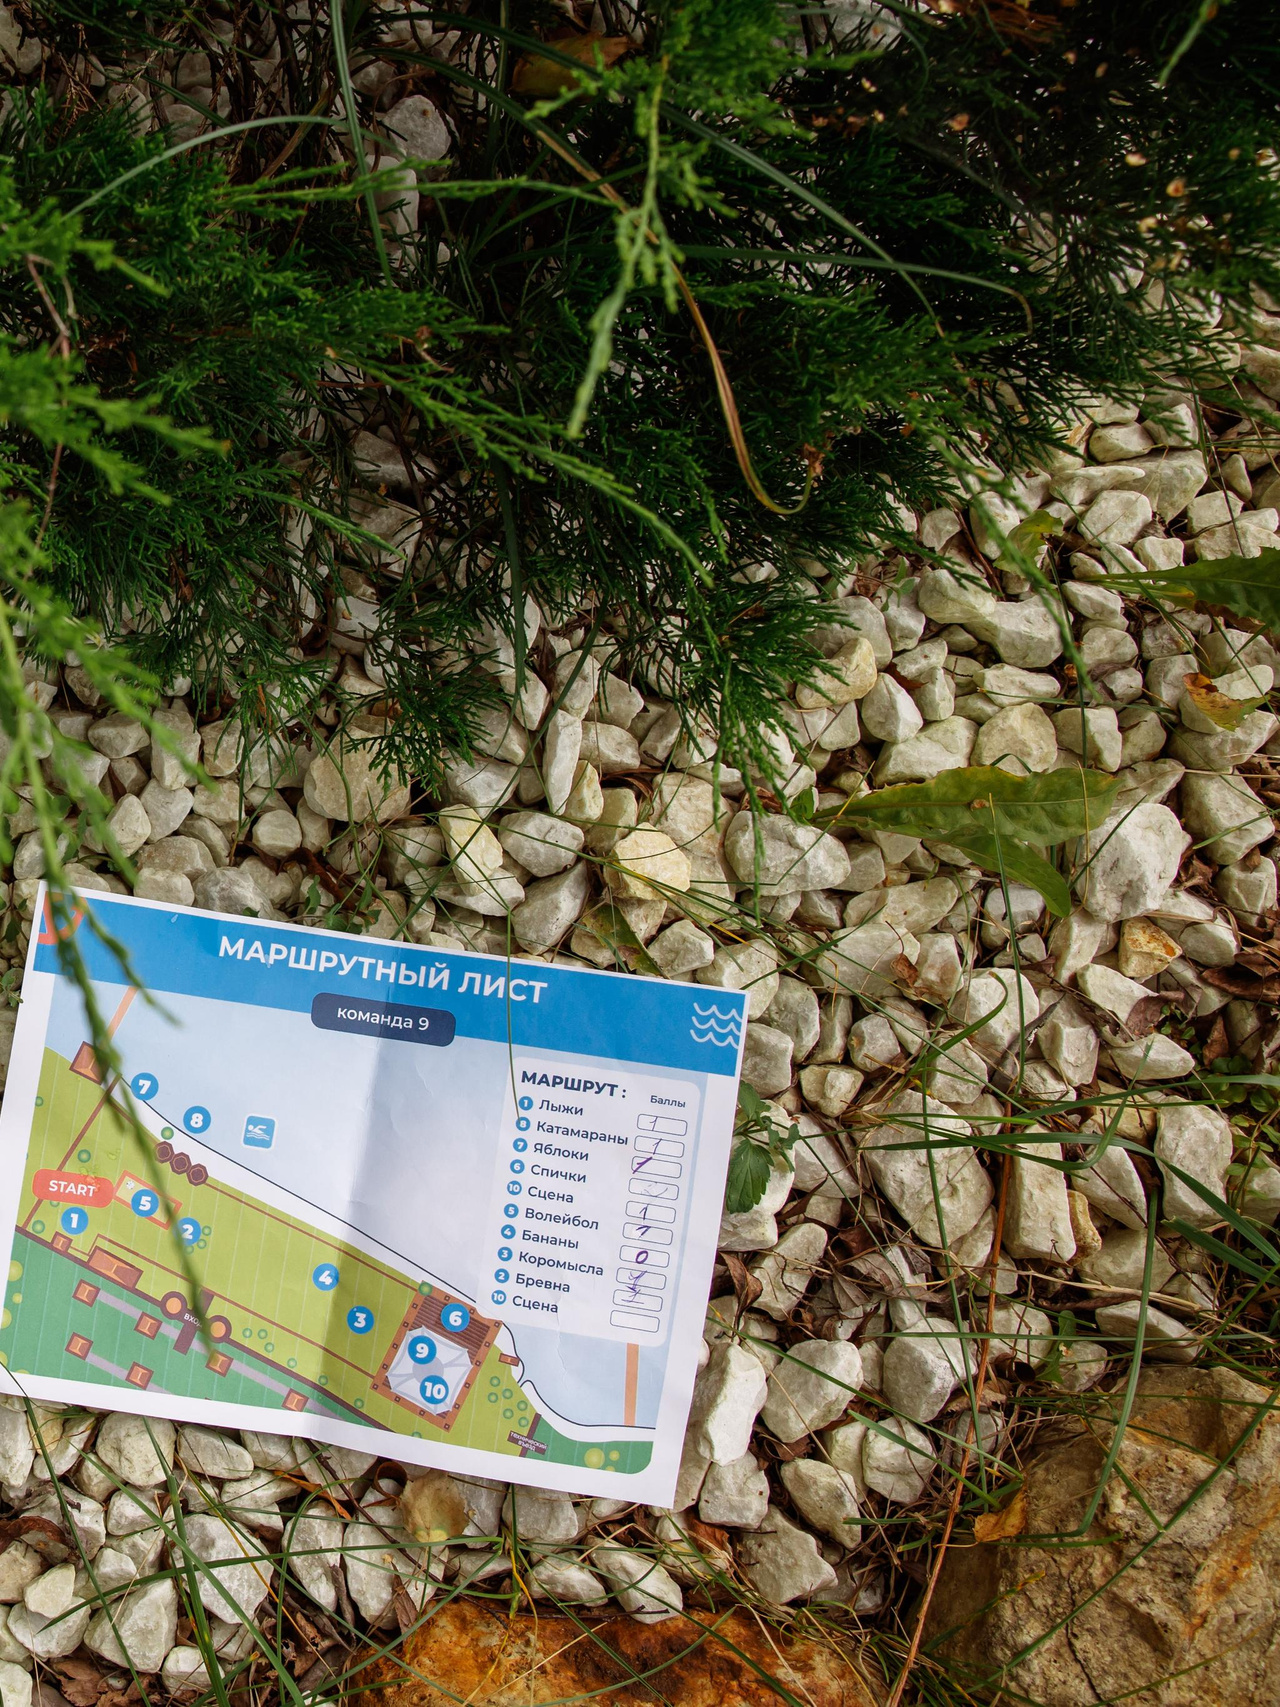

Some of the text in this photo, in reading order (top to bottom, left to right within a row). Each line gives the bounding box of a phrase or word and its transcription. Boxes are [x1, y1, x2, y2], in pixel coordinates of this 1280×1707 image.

[218, 935, 548, 1004] МАРШРУТНЫЙ ЛИСТ
[336, 1006, 430, 1031] команда 9
[138, 1079, 151, 1095] 7
[521, 1070, 618, 1097] МАРШРУТ
[539, 1099, 584, 1116] Лыжи
[650, 1095, 686, 1108] Баллы
[190, 1112, 203, 1128] 8
[536, 1120, 628, 1146] Катамараны
[533, 1142, 589, 1161] Яблоки
[530, 1164, 587, 1183] Спички
[48, 1180, 96, 1197] START
[509, 1184, 574, 1203] 10 Сцена
[138, 1196, 152, 1211] 5
[70, 1213, 79, 1228] 1
[525, 1207, 599, 1230] Волейбол
[181, 1224, 194, 1239] 2
[522, 1229, 579, 1250] Бананы
[519, 1251, 604, 1276] Коромысла
[318, 1270, 333, 1285] 4
[515, 1273, 570, 1293] Бревна
[493, 1293, 559, 1314] 10 Сцена
[354, 1312, 367, 1328] 3
[449, 1311, 463, 1326] 6
[415, 1343, 429, 1358] 9
[424, 1382, 446, 1399] 10
